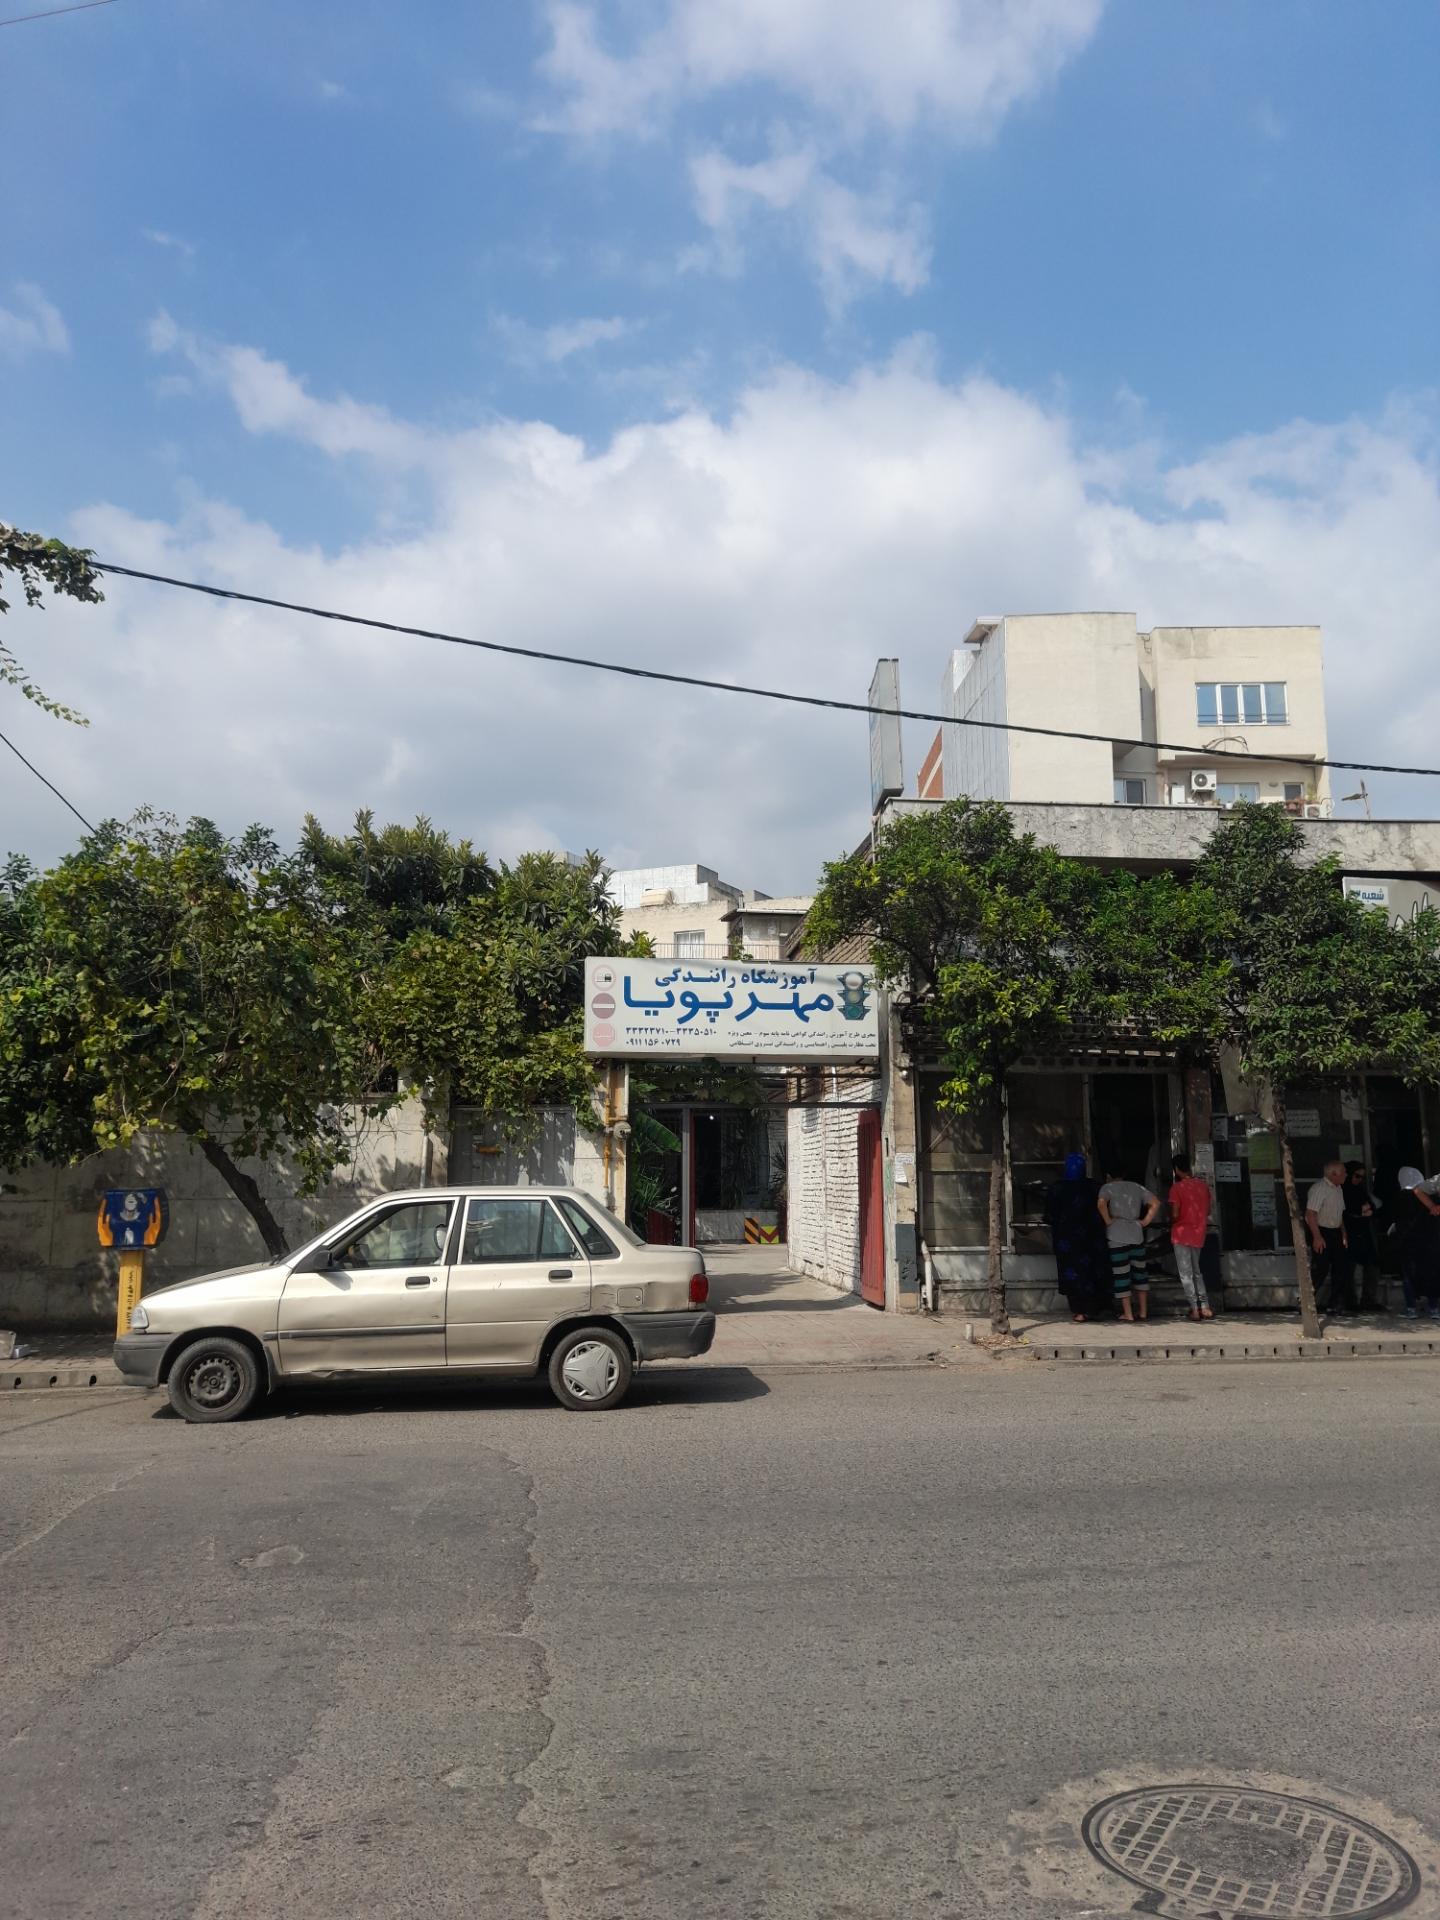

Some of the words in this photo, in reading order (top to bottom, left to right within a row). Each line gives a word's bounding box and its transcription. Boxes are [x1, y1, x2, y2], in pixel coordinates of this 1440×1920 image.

[1362, 888, 1384, 902] شعبه
[655, 967, 736, 988] رانندگی
[741, 967, 817, 989] آموزشگاه
[728, 1040, 754, 1048] انتظامی
[830, 1040, 847, 1048] پلیس
